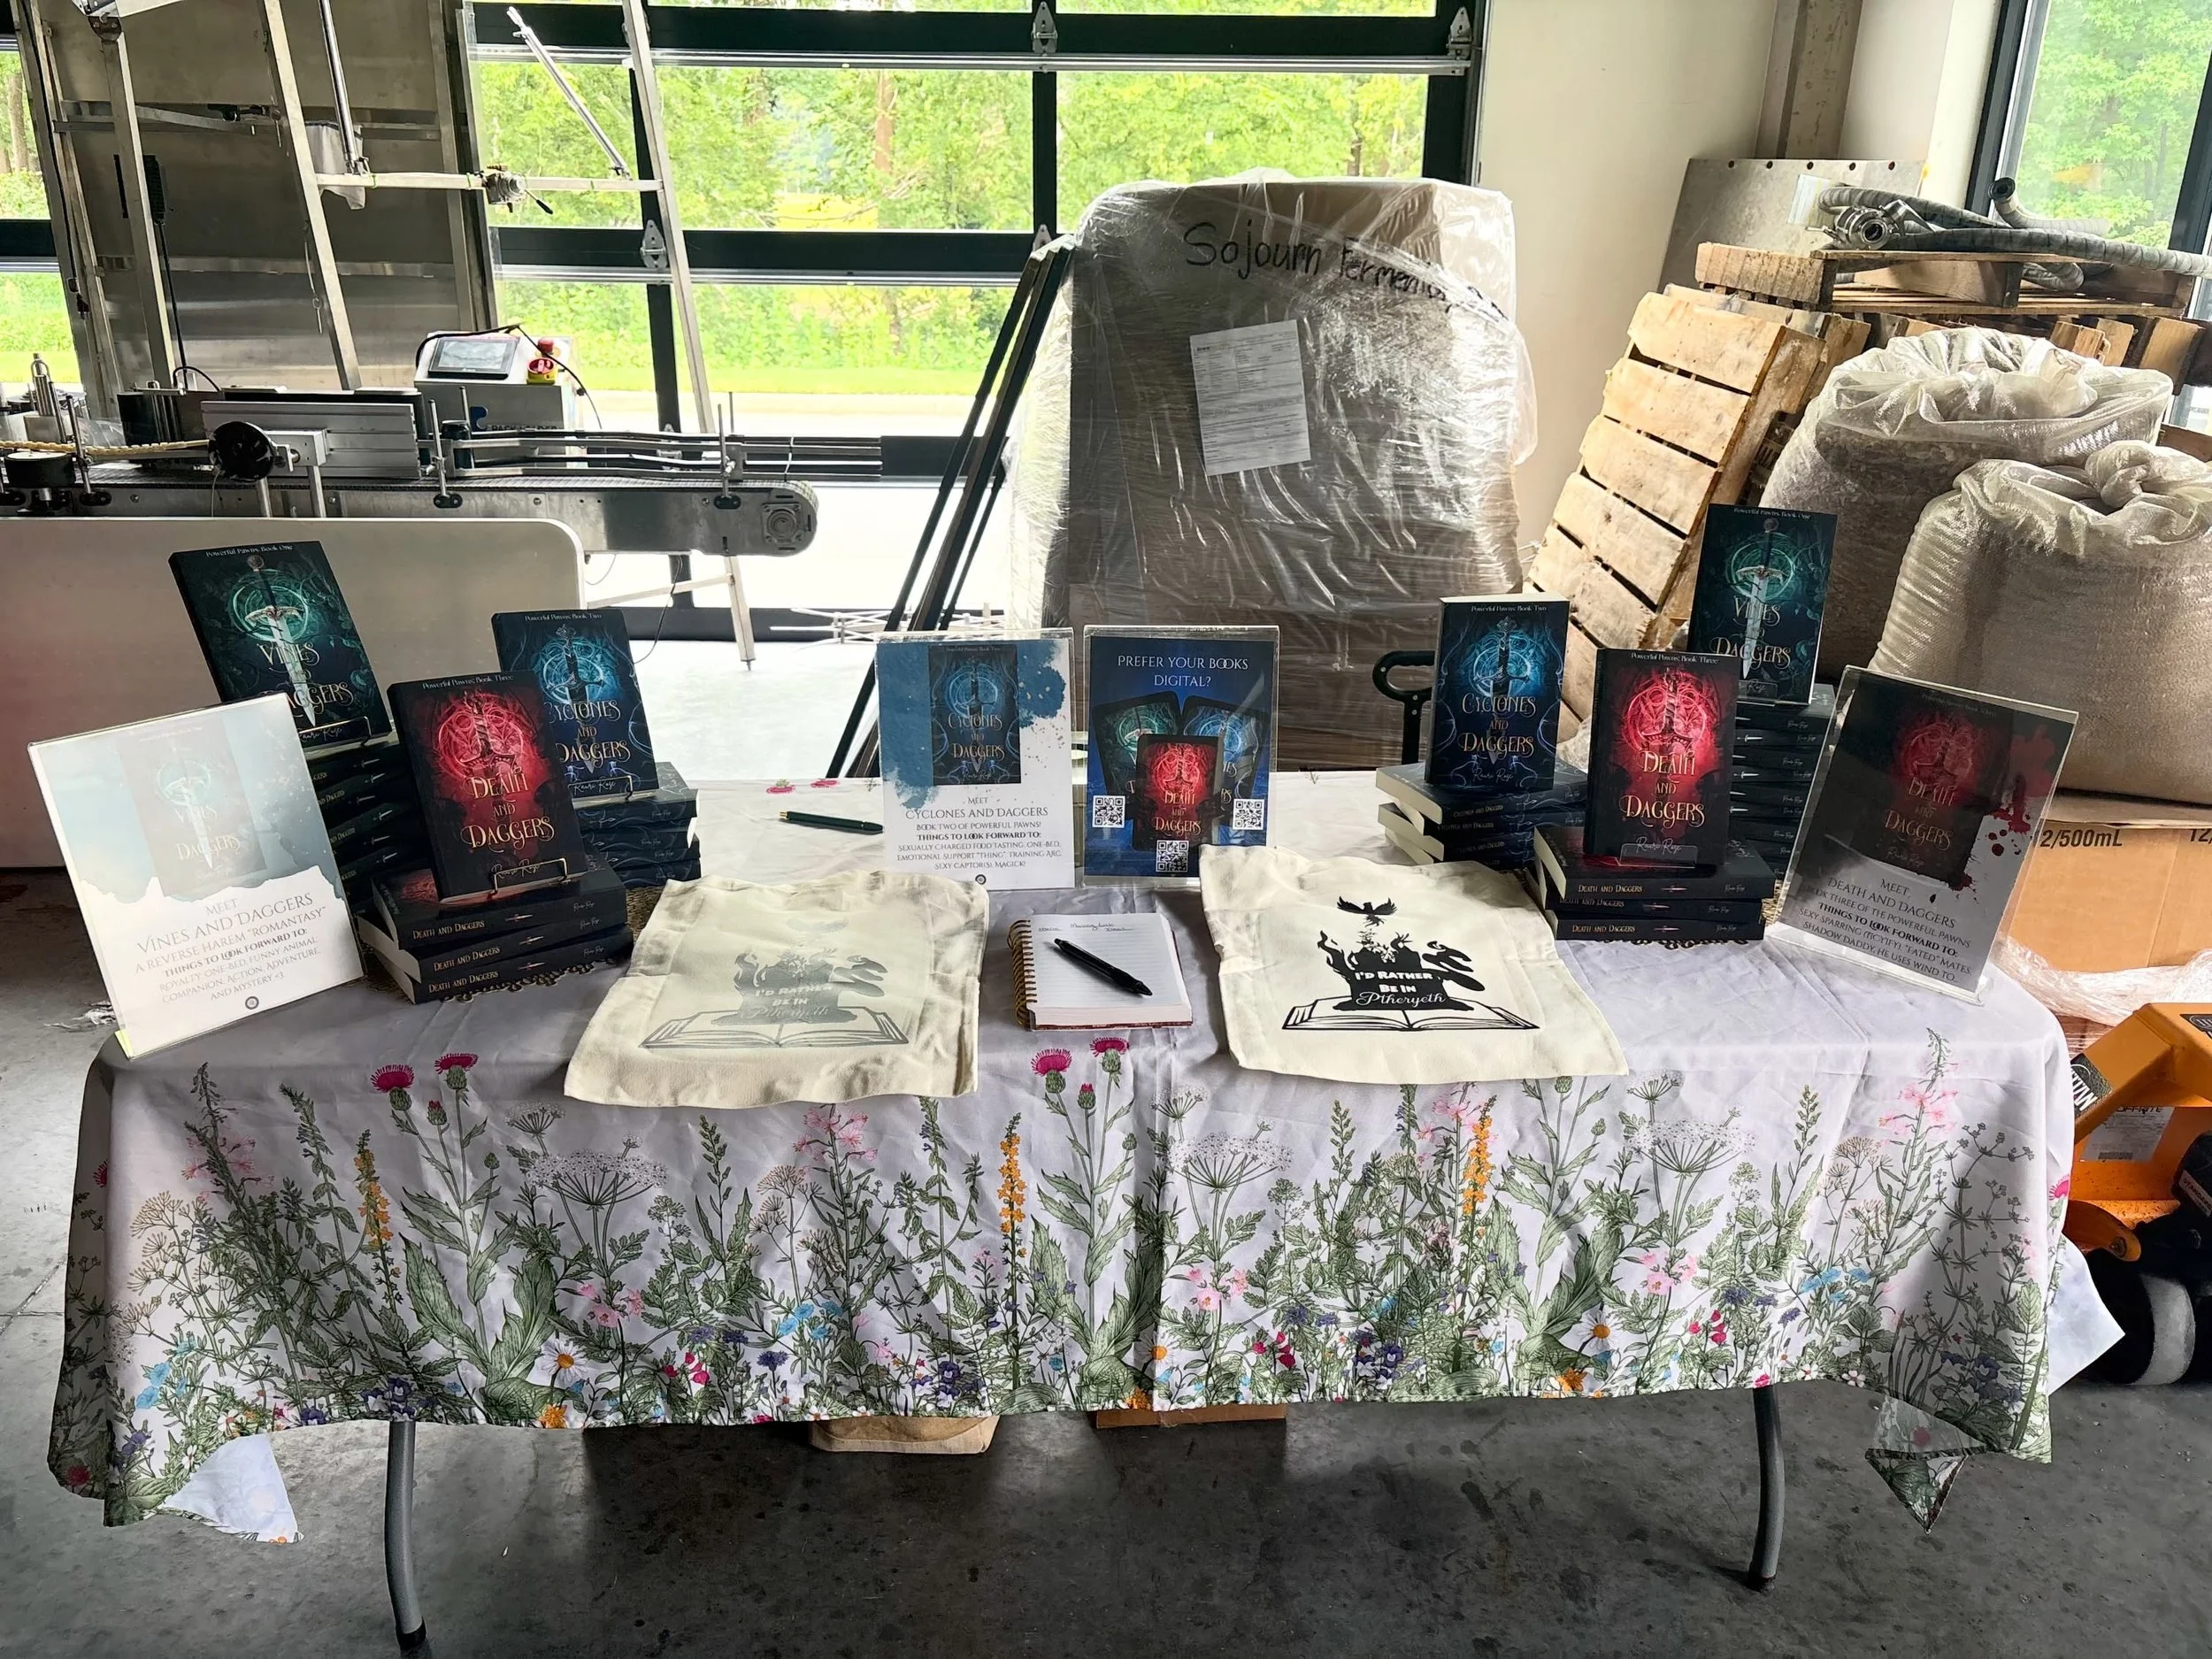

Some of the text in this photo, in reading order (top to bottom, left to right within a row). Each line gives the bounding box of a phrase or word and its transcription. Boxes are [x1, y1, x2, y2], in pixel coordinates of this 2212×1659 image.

[1183, 219, 1322, 280] Sojourn
[206, 548, 236, 557] Powerful
[261, 544, 278, 553] Book
[1118, 655, 1248, 670] PREFER YOUR BOOKS
[1631, 652, 1657, 661] Powerful
[422, 680, 450, 689] Powerful
[475, 675, 493, 684] Book
[1154, 674, 1211, 687] DIGITAL?
[285, 681, 354, 714] AGGERS
[1463, 693, 1536, 717] CYCLONES
[577, 726, 597, 738] AND
[1489, 720, 1509, 730] AND
[1460, 733, 1535, 758] DAGGERS
[1641, 750, 1696, 776] DEATH
[463, 767, 530, 799] DEATH
[1655, 781, 1677, 794] AND
[493, 803, 516, 818] AND
[906, 807, 1048, 819] CYCLONES AND DAGGERS
[1621, 795, 1705, 828] DAGGERS
[461, 816, 555, 853] DAGGERS
[897, 853, 941, 862] EMOTIONAL
[1881, 879, 1909, 895] MEET
[205, 898, 238, 916] MEET
[1828, 877, 1956, 928] DEATH AND DAGGERS
[138, 893, 313, 954] VINES AND DAGGERS
[412, 919, 485, 940] DEATH AND DAGGERS
[1572, 924, 1592, 933] DEATH
[1609, 925, 1636, 933] DAGGERS
[1799, 907, 1819, 920] SEXY
[1820, 914, 1862, 936] SPARRING
[1818, 902, 1958, 957] THINGS TO LOOK FORWARD TO:
[1830, 893, 1855, 909] THREE
[1857, 903, 1870, 912] OF
[1872, 908, 1886, 919] THE
[1886, 913, 1939, 938] POWERFUL
[1938, 931, 1971, 949] PAWNS
[134, 906, 326, 973] A REVERSE HAREM "ROMANTASY"
[248, 948, 280, 964] FUNNY
[282, 936, 319, 954] ANIMAL
[1802, 920, 1841, 940] SHADOW
[1877, 947, 1890, 958] HE
[1891, 952, 1911, 966] USES
[1913, 960, 1939, 976] WIND
[164, 928, 308, 978] THINGS TO LOOK FORWARD TO:
[434, 947, 501, 972] DEATH AND DAGGERS
[428, 970, 499, 994] DEATH AND DAGGERS
[1355, 971, 1433, 980] I'D RATHER
[210, 987, 232, 1001] AND
[234, 975, 273, 995] MYSTERY
[778, 985, 833, 995] RATHER
[1379, 984, 1398, 993] BE
